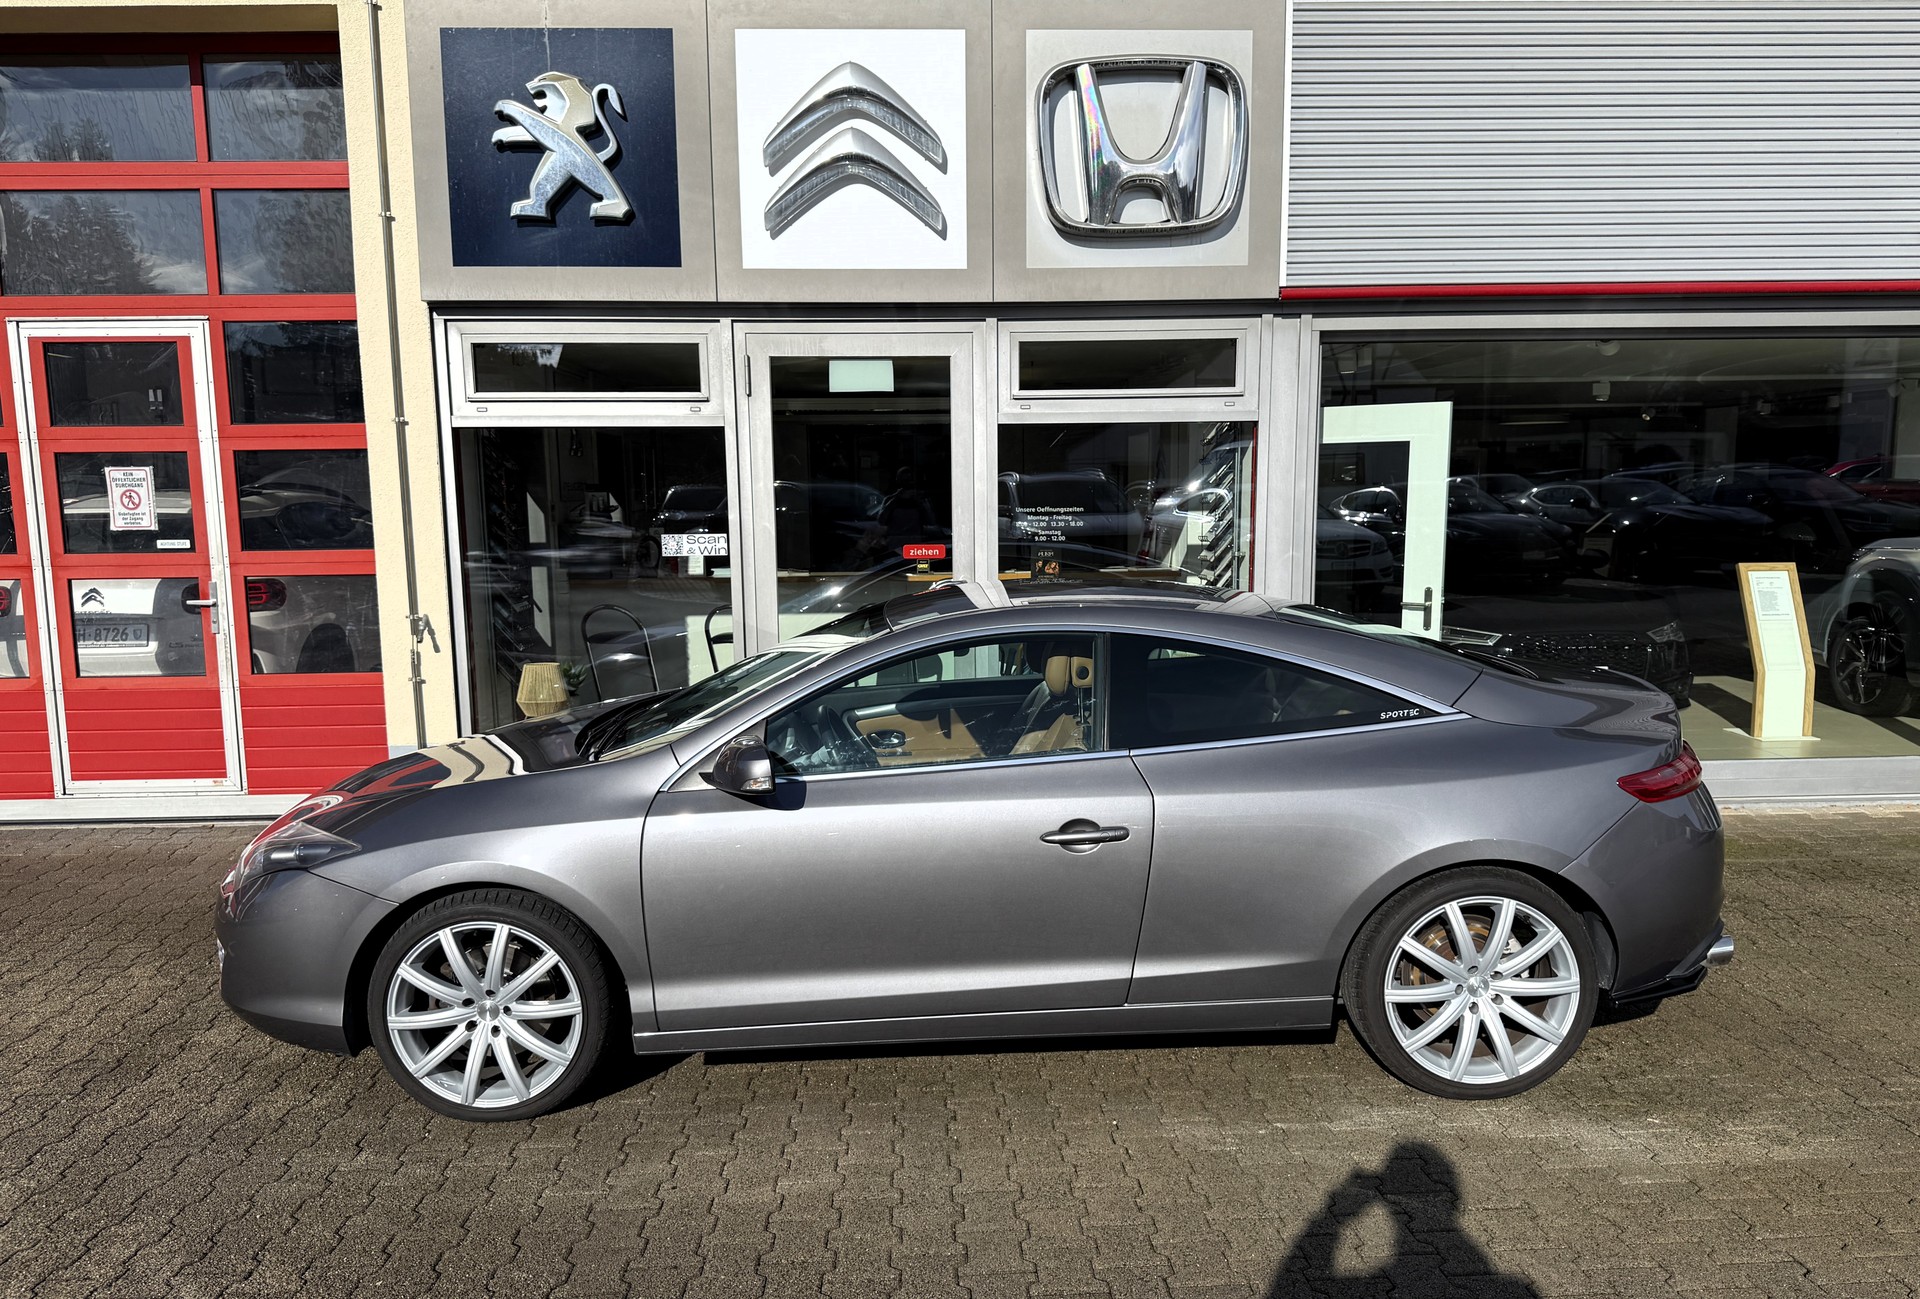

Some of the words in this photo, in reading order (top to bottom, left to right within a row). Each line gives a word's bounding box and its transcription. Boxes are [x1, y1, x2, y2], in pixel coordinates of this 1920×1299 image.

[686, 535, 726, 544] Scan
[698, 544, 728, 554] Win
[76, 628, 129, 642] H·8726
[1380, 708, 1420, 719] SPORTEC
